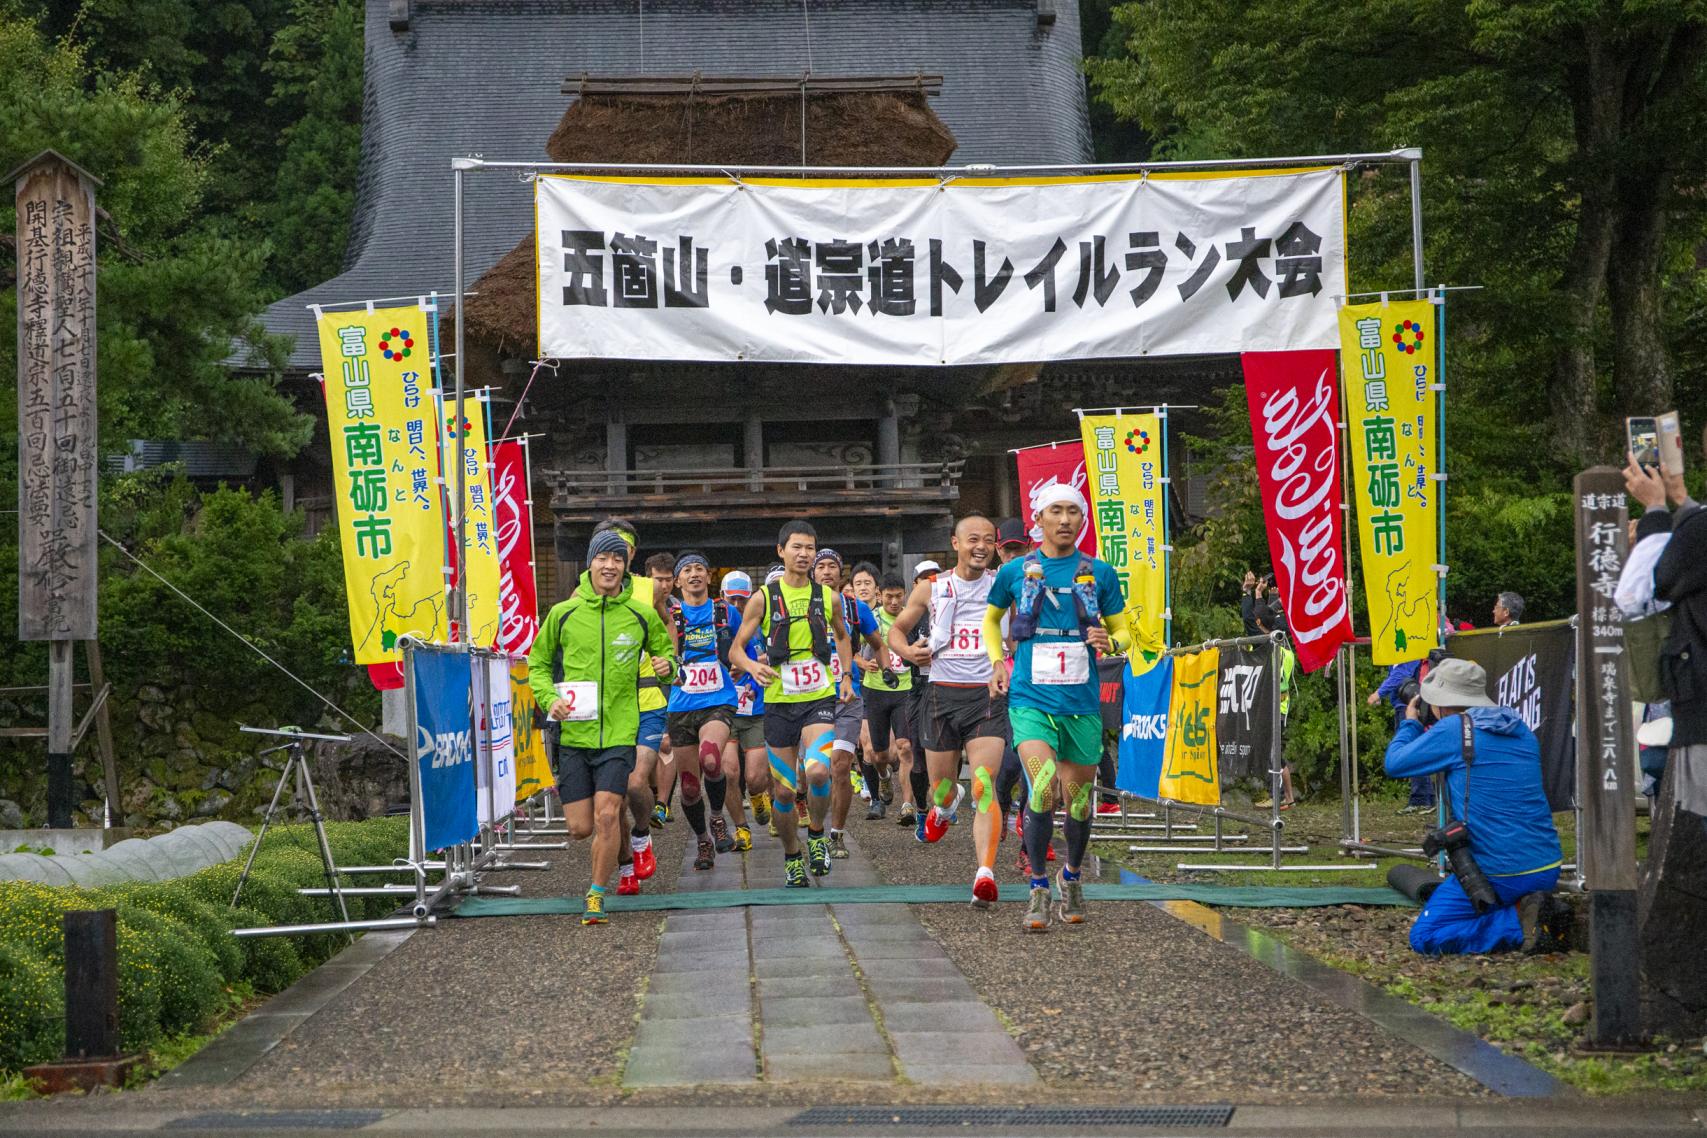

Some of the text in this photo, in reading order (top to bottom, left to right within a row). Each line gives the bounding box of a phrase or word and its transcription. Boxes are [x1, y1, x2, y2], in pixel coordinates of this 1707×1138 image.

[560, 220, 1324, 317] 五箇山・道宗道トレイルラン大会
[401, 370, 421, 408] ひらけ
[337, 325, 393, 560] 富山県南砺市
[1355, 316, 1405, 557] 富山県南砺市
[387, 428, 407, 502] なんと
[1141, 462, 1153, 490] ひらけ
[1401, 422, 1416, 498] なんと
[1581, 492, 1628, 510] 道宗道
[1130, 504, 1143, 561] なんと
[1592, 606, 1622, 622] 標高
[1592, 625, 1623, 637] 340m
[689, 668, 717, 686] 204
[791, 662, 821, 687] 155
[1057, 651, 1065, 674] 1
[1498, 653, 1537, 708] FLAT IS
[566, 690, 576, 711] 2
